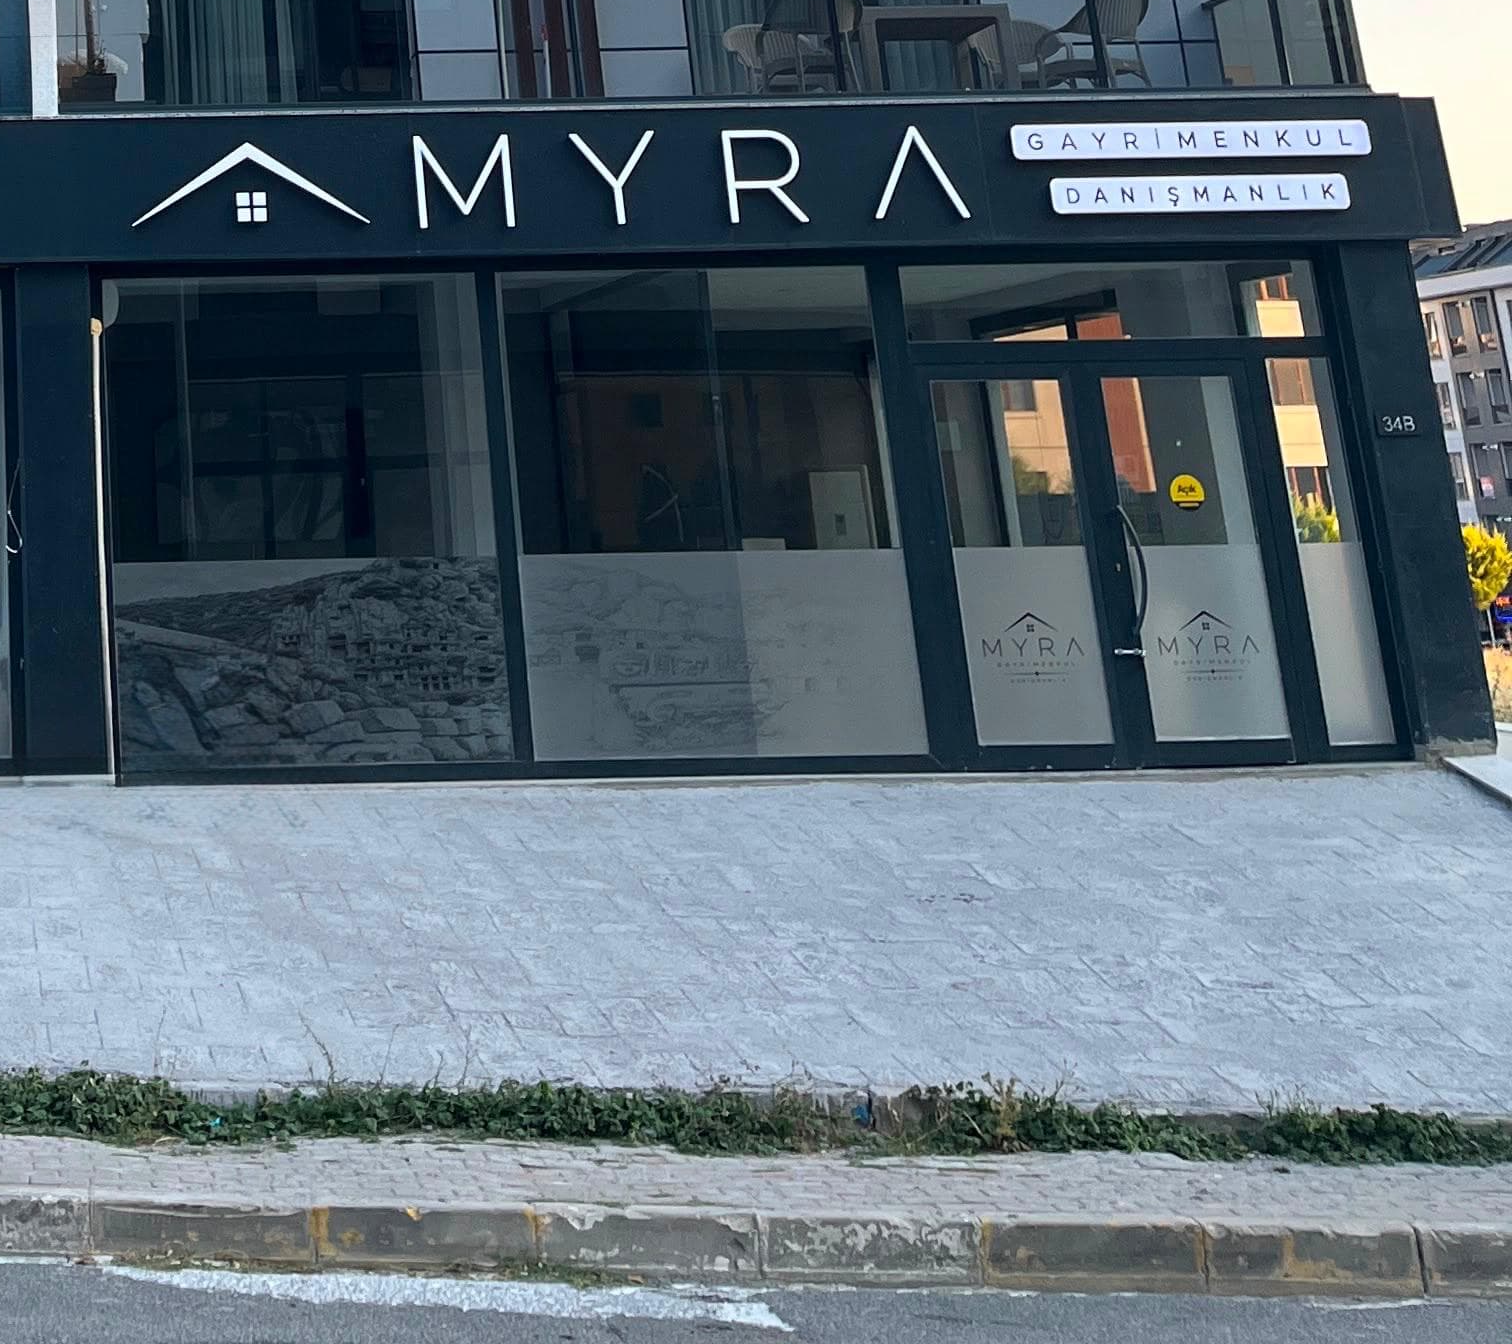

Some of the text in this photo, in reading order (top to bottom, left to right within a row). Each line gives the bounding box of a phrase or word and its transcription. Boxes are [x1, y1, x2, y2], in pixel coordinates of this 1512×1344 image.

[1027, 127, 1353, 152] GAYRİMENKUL
[412, 124, 971, 230] MYRA
[1065, 182, 1336, 208] DANIŞMANLIK
[1382, 415, 1416, 432] 34B
[981, 637, 1086, 657] MYRA
[1158, 634, 1260, 655] MYRA
